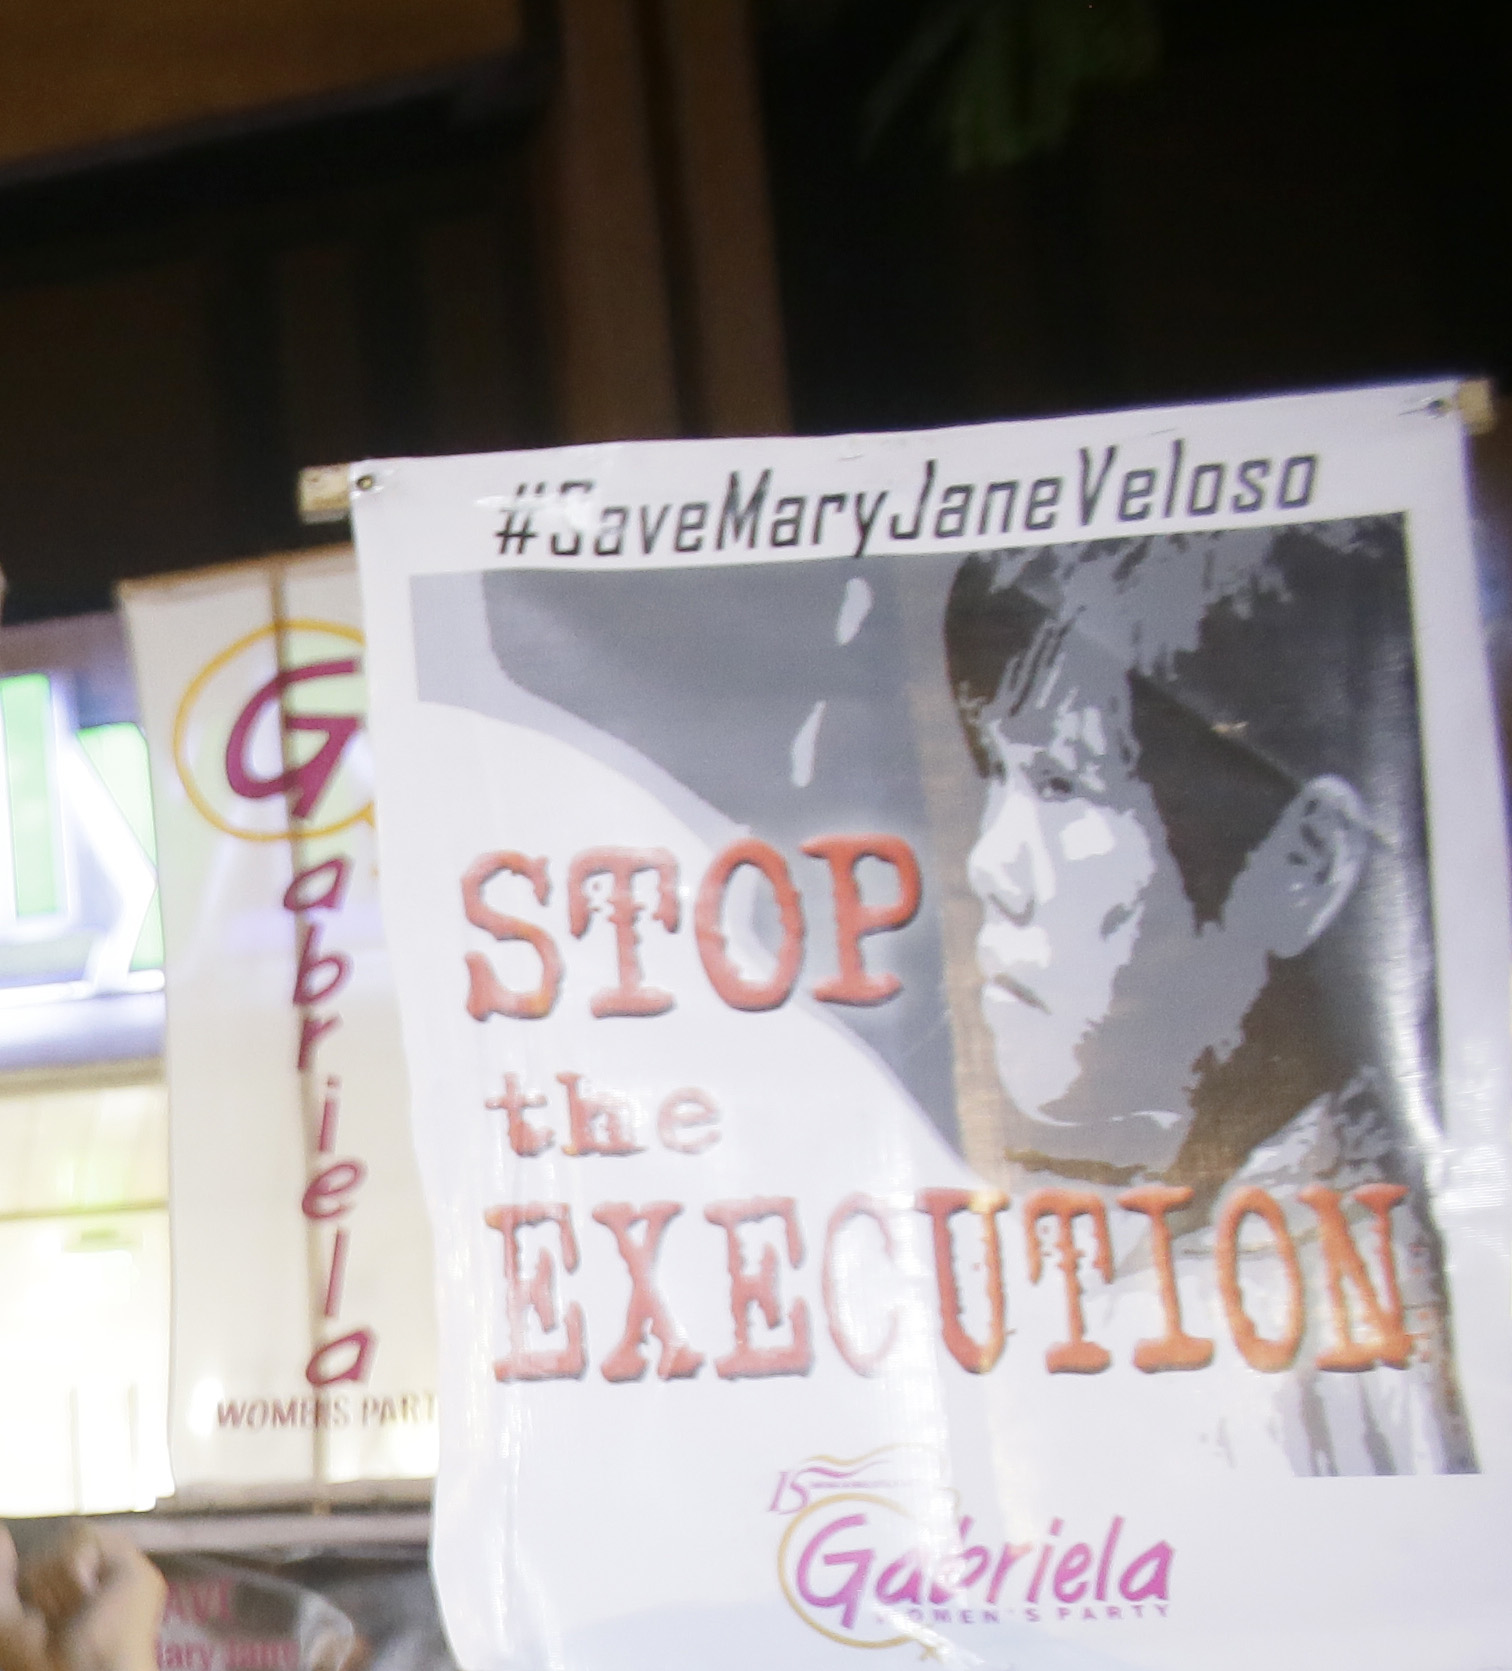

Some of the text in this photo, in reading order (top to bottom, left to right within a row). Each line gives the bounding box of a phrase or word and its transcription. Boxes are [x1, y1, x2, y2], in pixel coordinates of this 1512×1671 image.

[495, 438, 1320, 558] #SaveMaryJaneVeloso
[462, 834, 921, 1022] STOP
[484, 1070, 722, 1157] the
[484, 1183, 1416, 1384] EXECUTION
[796, 1513, 1174, 1630] Gabriela
[875, 1602, 1169, 1625] OMEN'S PARTY
